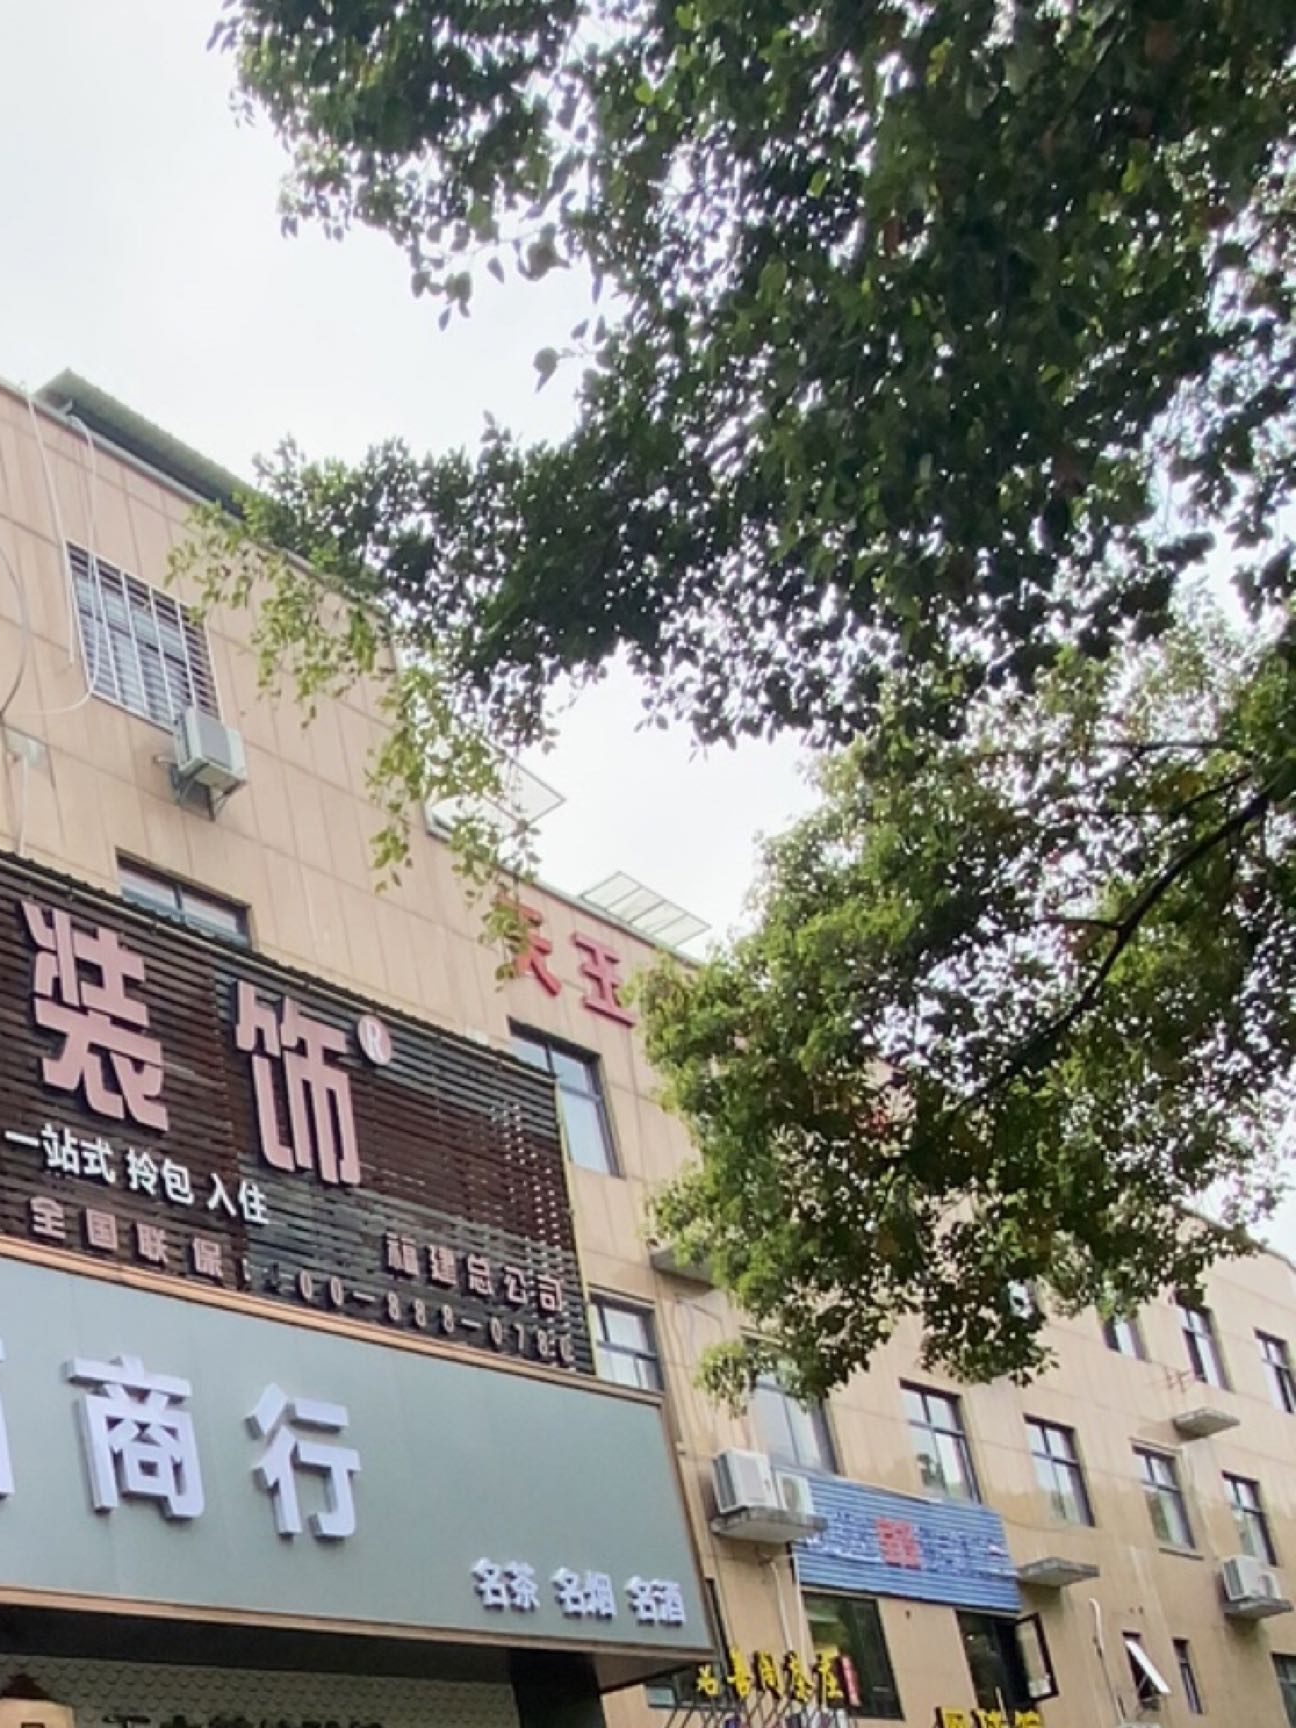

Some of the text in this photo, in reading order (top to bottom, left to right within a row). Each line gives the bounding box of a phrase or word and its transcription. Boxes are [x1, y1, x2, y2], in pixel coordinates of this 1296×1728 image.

[386, 1231, 564, 1312] 福建总公司
